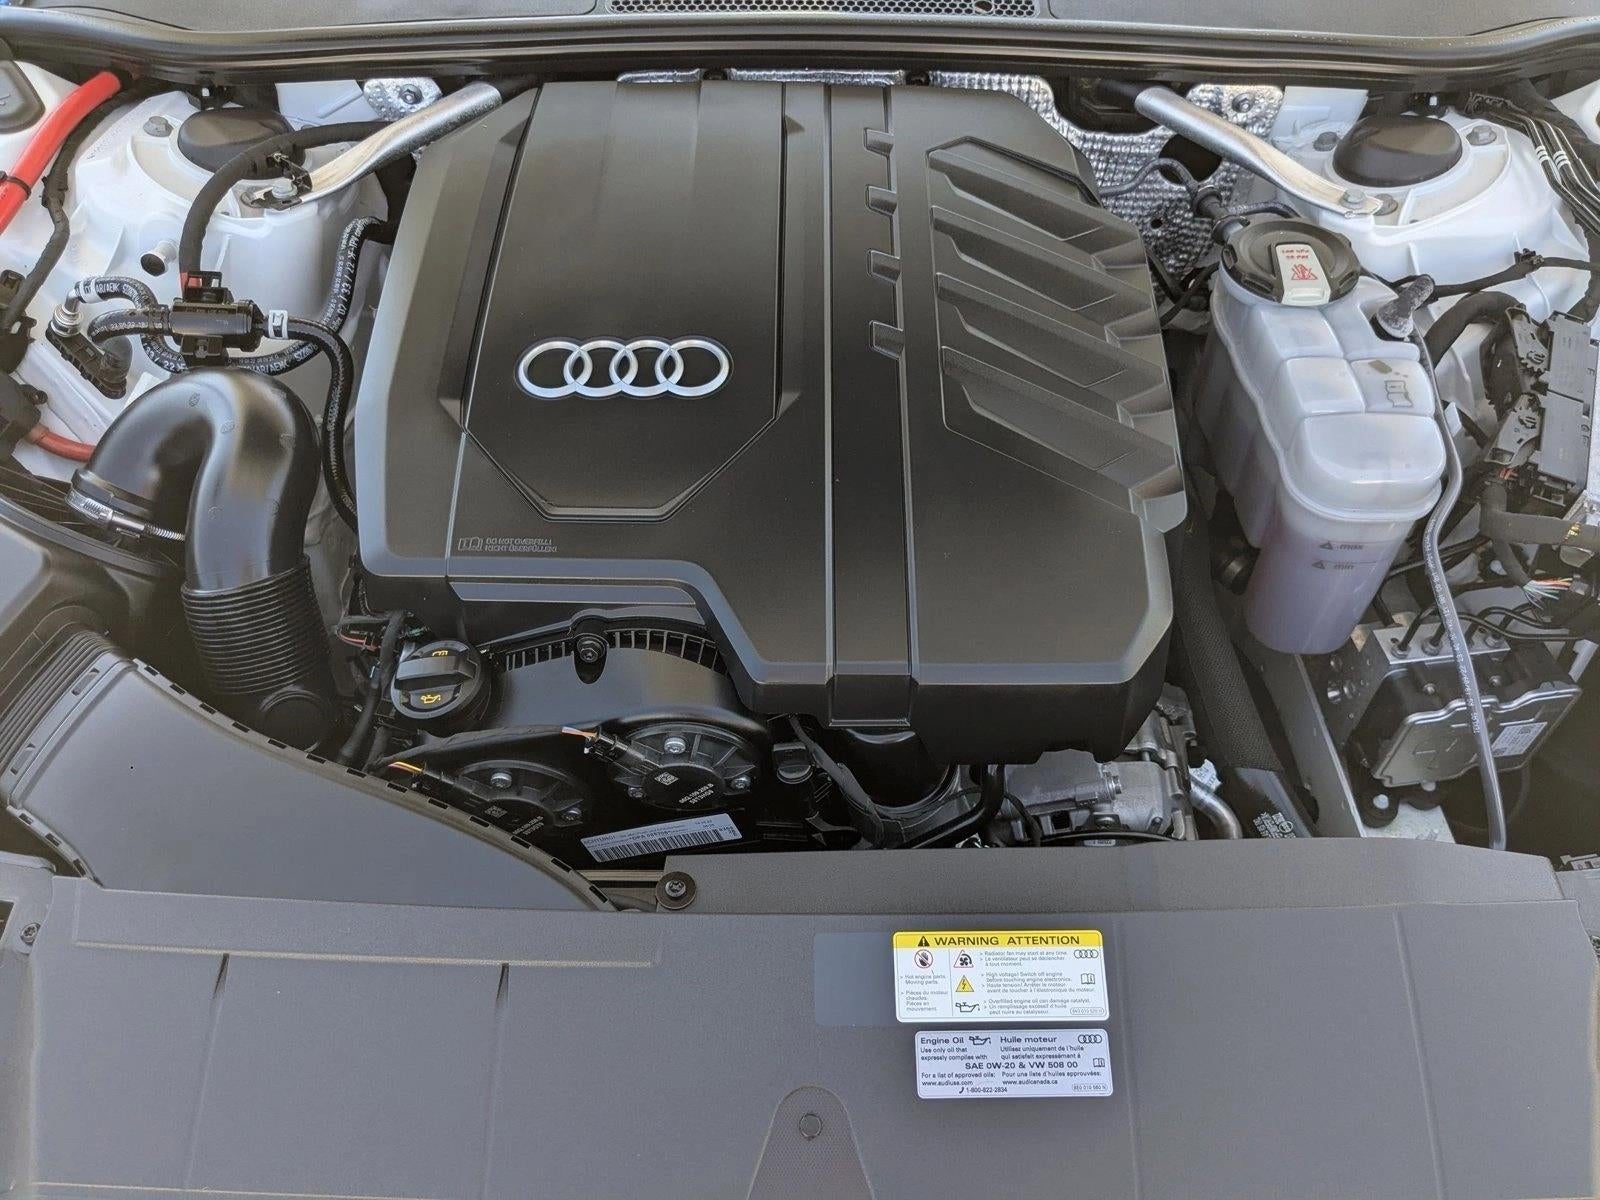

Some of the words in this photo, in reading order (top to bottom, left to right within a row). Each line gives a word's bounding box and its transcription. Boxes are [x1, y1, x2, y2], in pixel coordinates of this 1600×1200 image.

[934, 936, 999, 946] WARNING
[1007, 935, 1080, 945] ATTENTION
[920, 1037, 950, 1045] Engine
[952, 1036, 964, 1044] Oil
